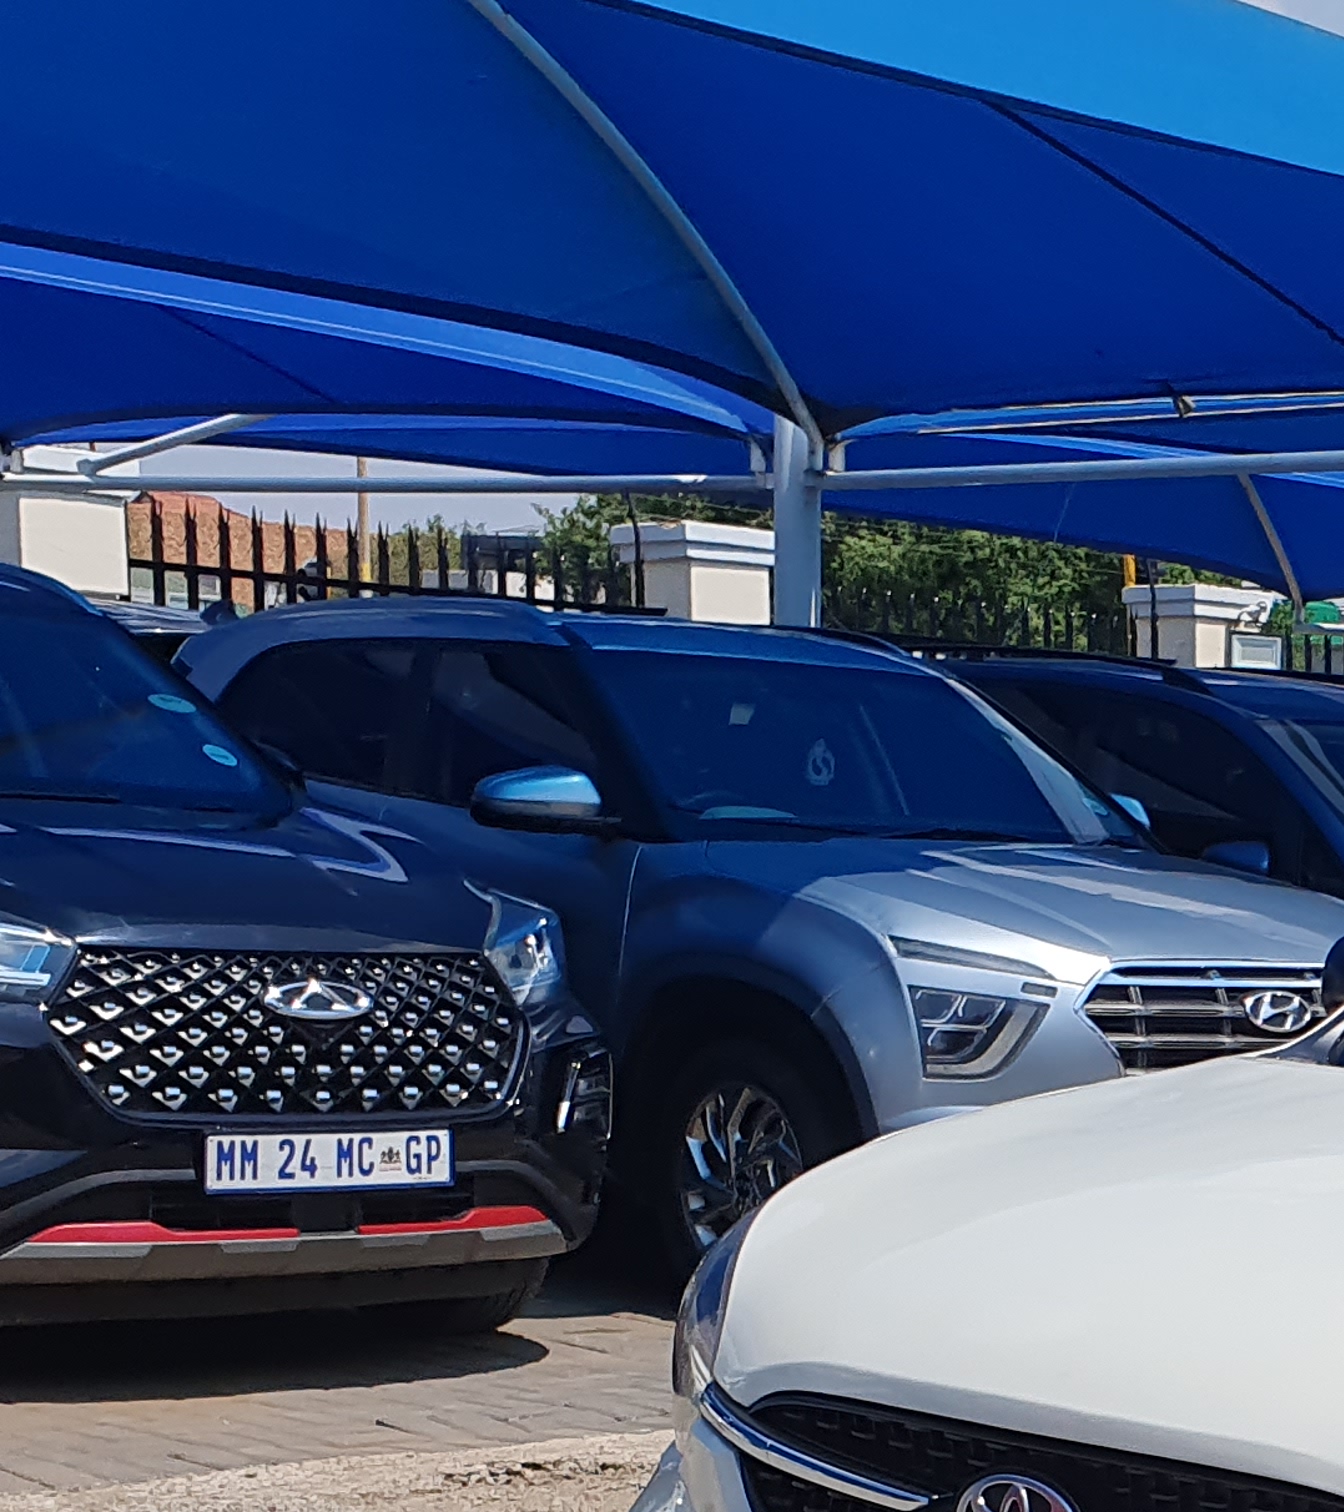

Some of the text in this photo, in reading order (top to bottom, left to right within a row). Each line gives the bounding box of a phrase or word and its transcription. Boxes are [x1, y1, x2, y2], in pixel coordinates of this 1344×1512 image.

[216, 1134, 441, 1181] MM 24 MC GP
